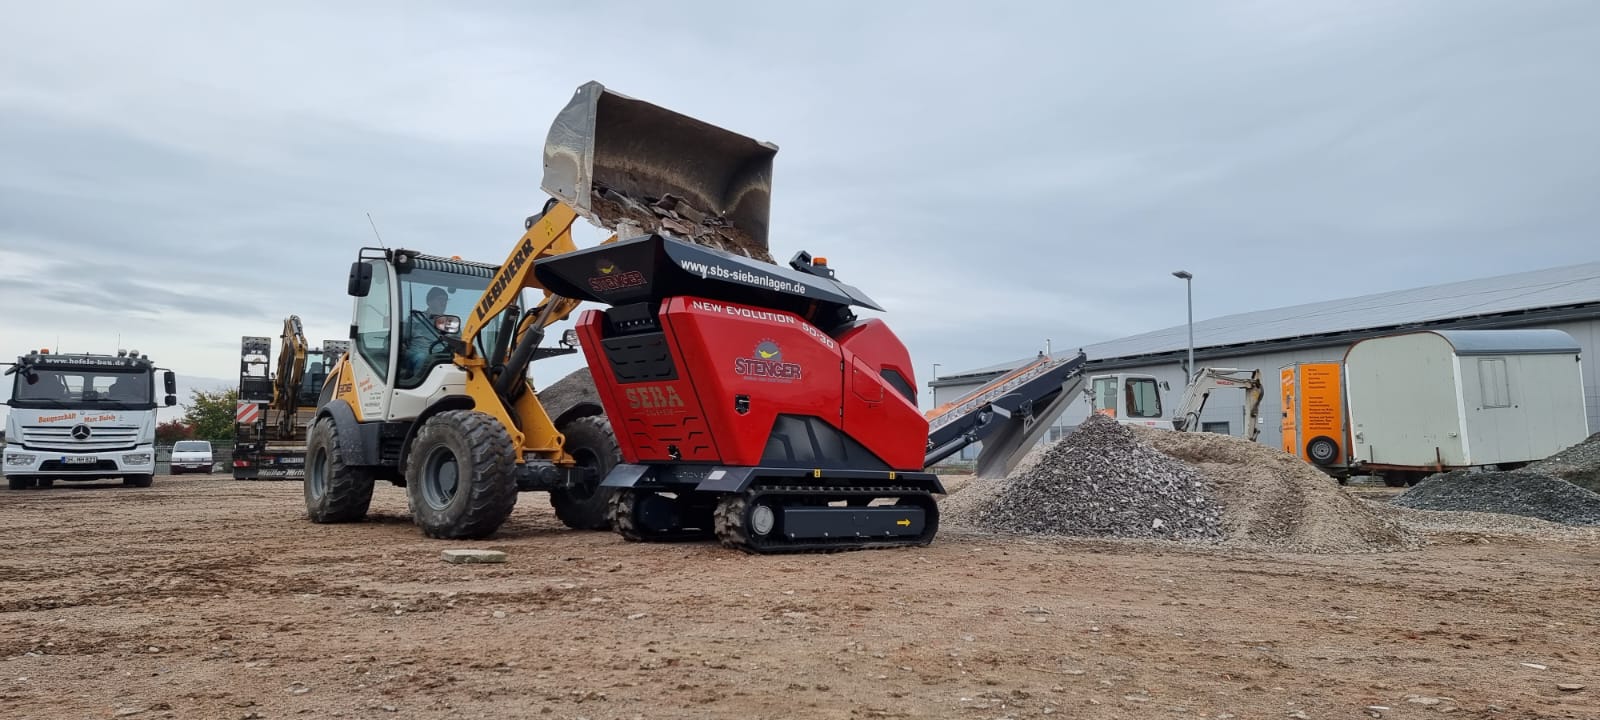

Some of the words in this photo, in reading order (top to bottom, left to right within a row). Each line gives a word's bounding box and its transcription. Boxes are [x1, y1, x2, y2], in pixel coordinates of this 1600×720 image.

[476, 238, 535, 321] LIEBHERR
[680, 259, 806, 295] www.sbs-siebanlagen.de
[692, 300, 722, 313] NEW
[726, 304, 795, 325] EVOLUTION
[735, 357, 802, 380] STENGER
[625, 385, 684, 409] SEBA
